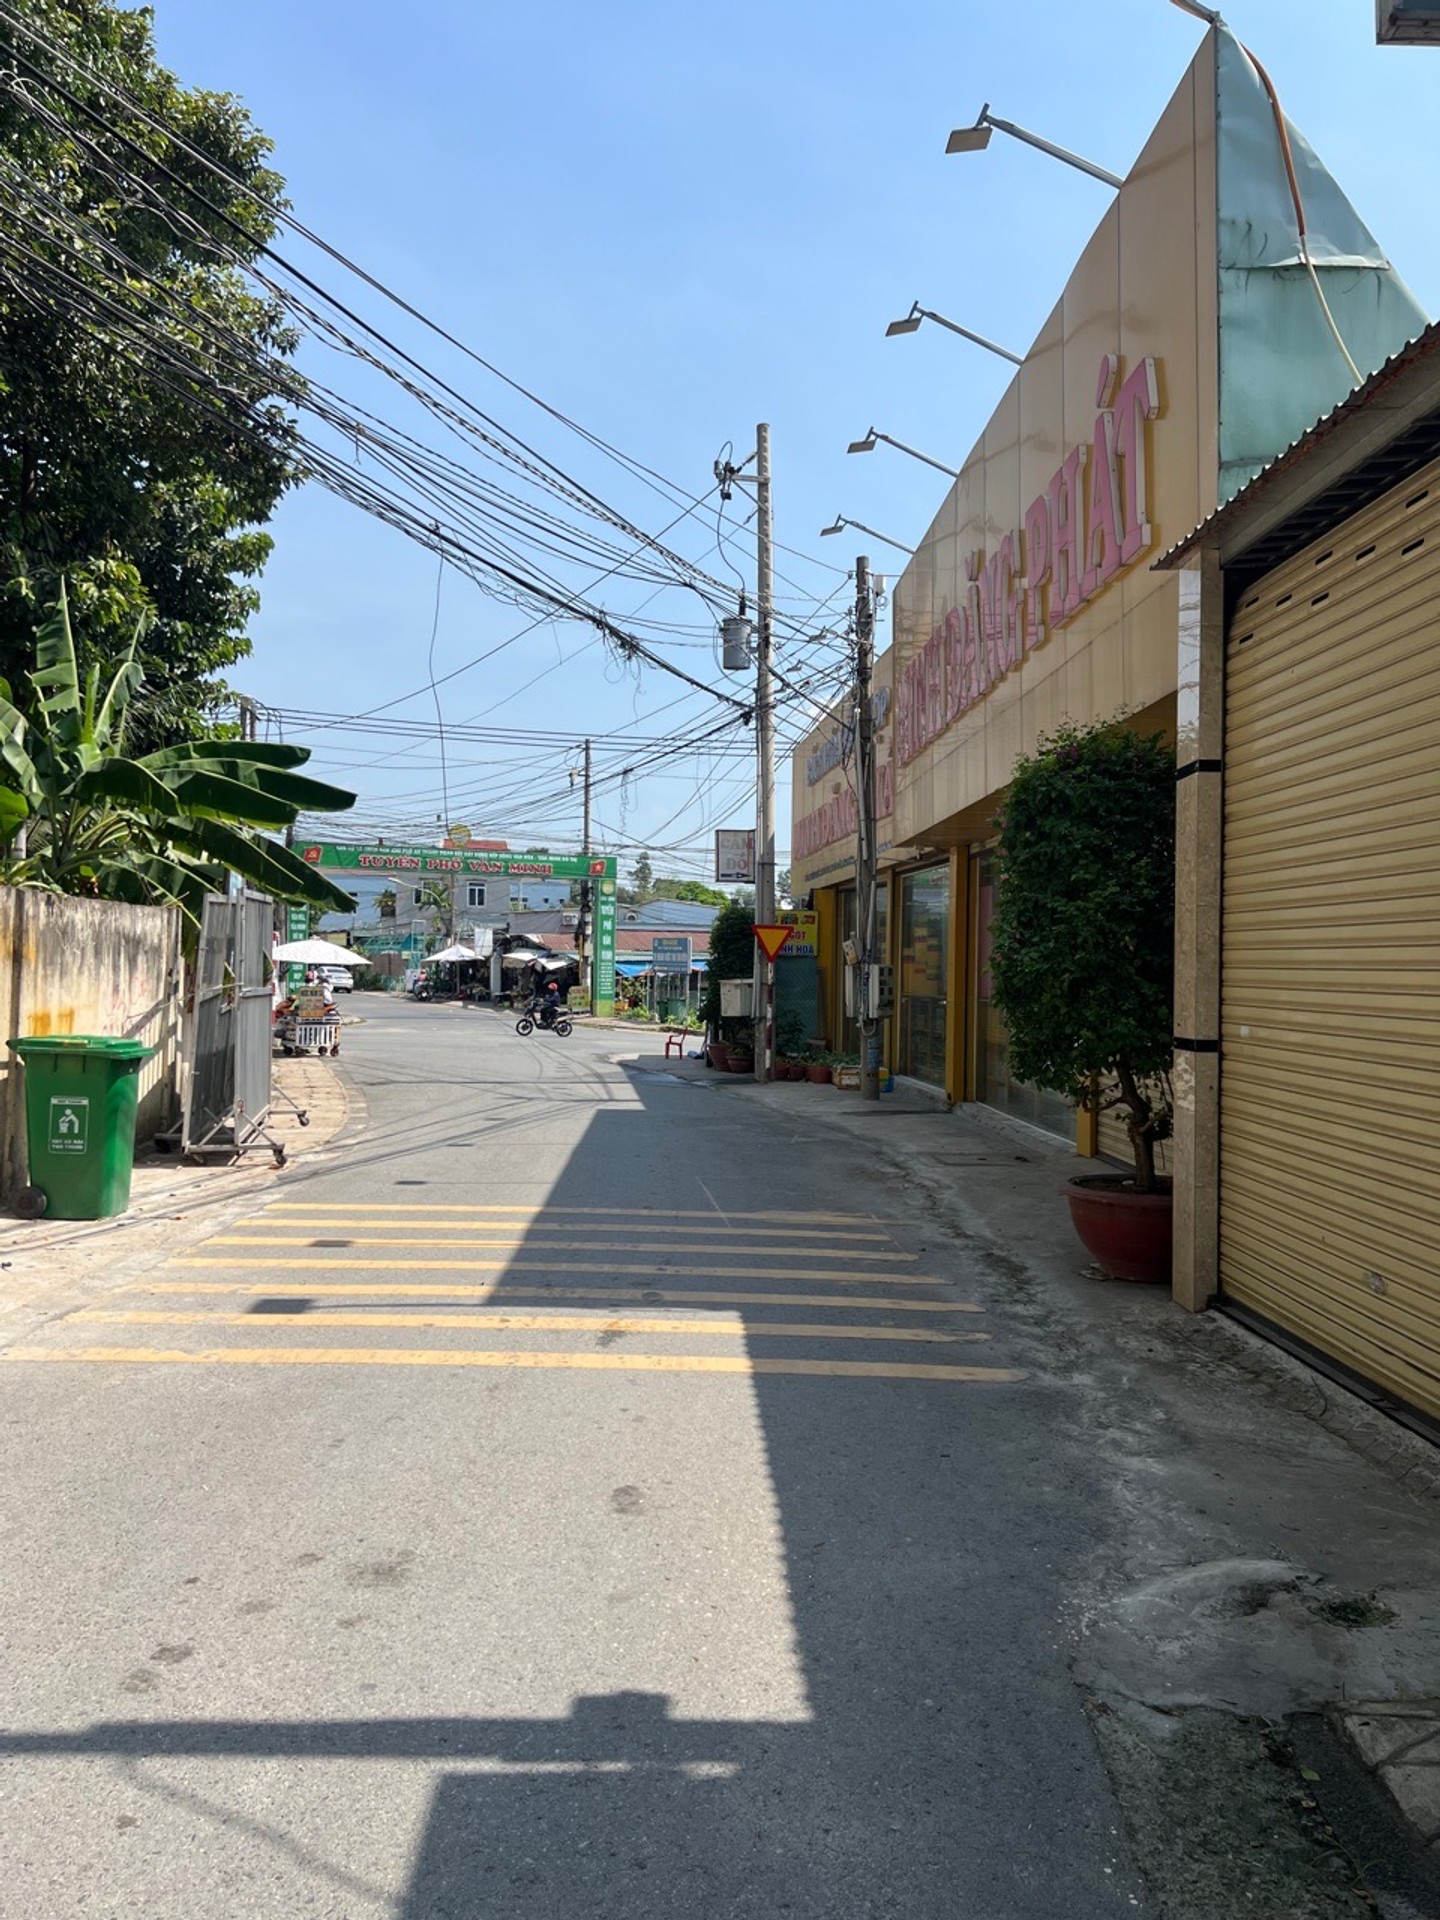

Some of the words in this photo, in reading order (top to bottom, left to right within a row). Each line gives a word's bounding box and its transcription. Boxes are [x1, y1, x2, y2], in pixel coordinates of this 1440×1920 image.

[1024, 354, 1160, 652] PHÁT
[427, 854, 463, 872] PHỐ
[467, 858, 504, 873] VĂN
[508, 863, 553, 874] MINH
